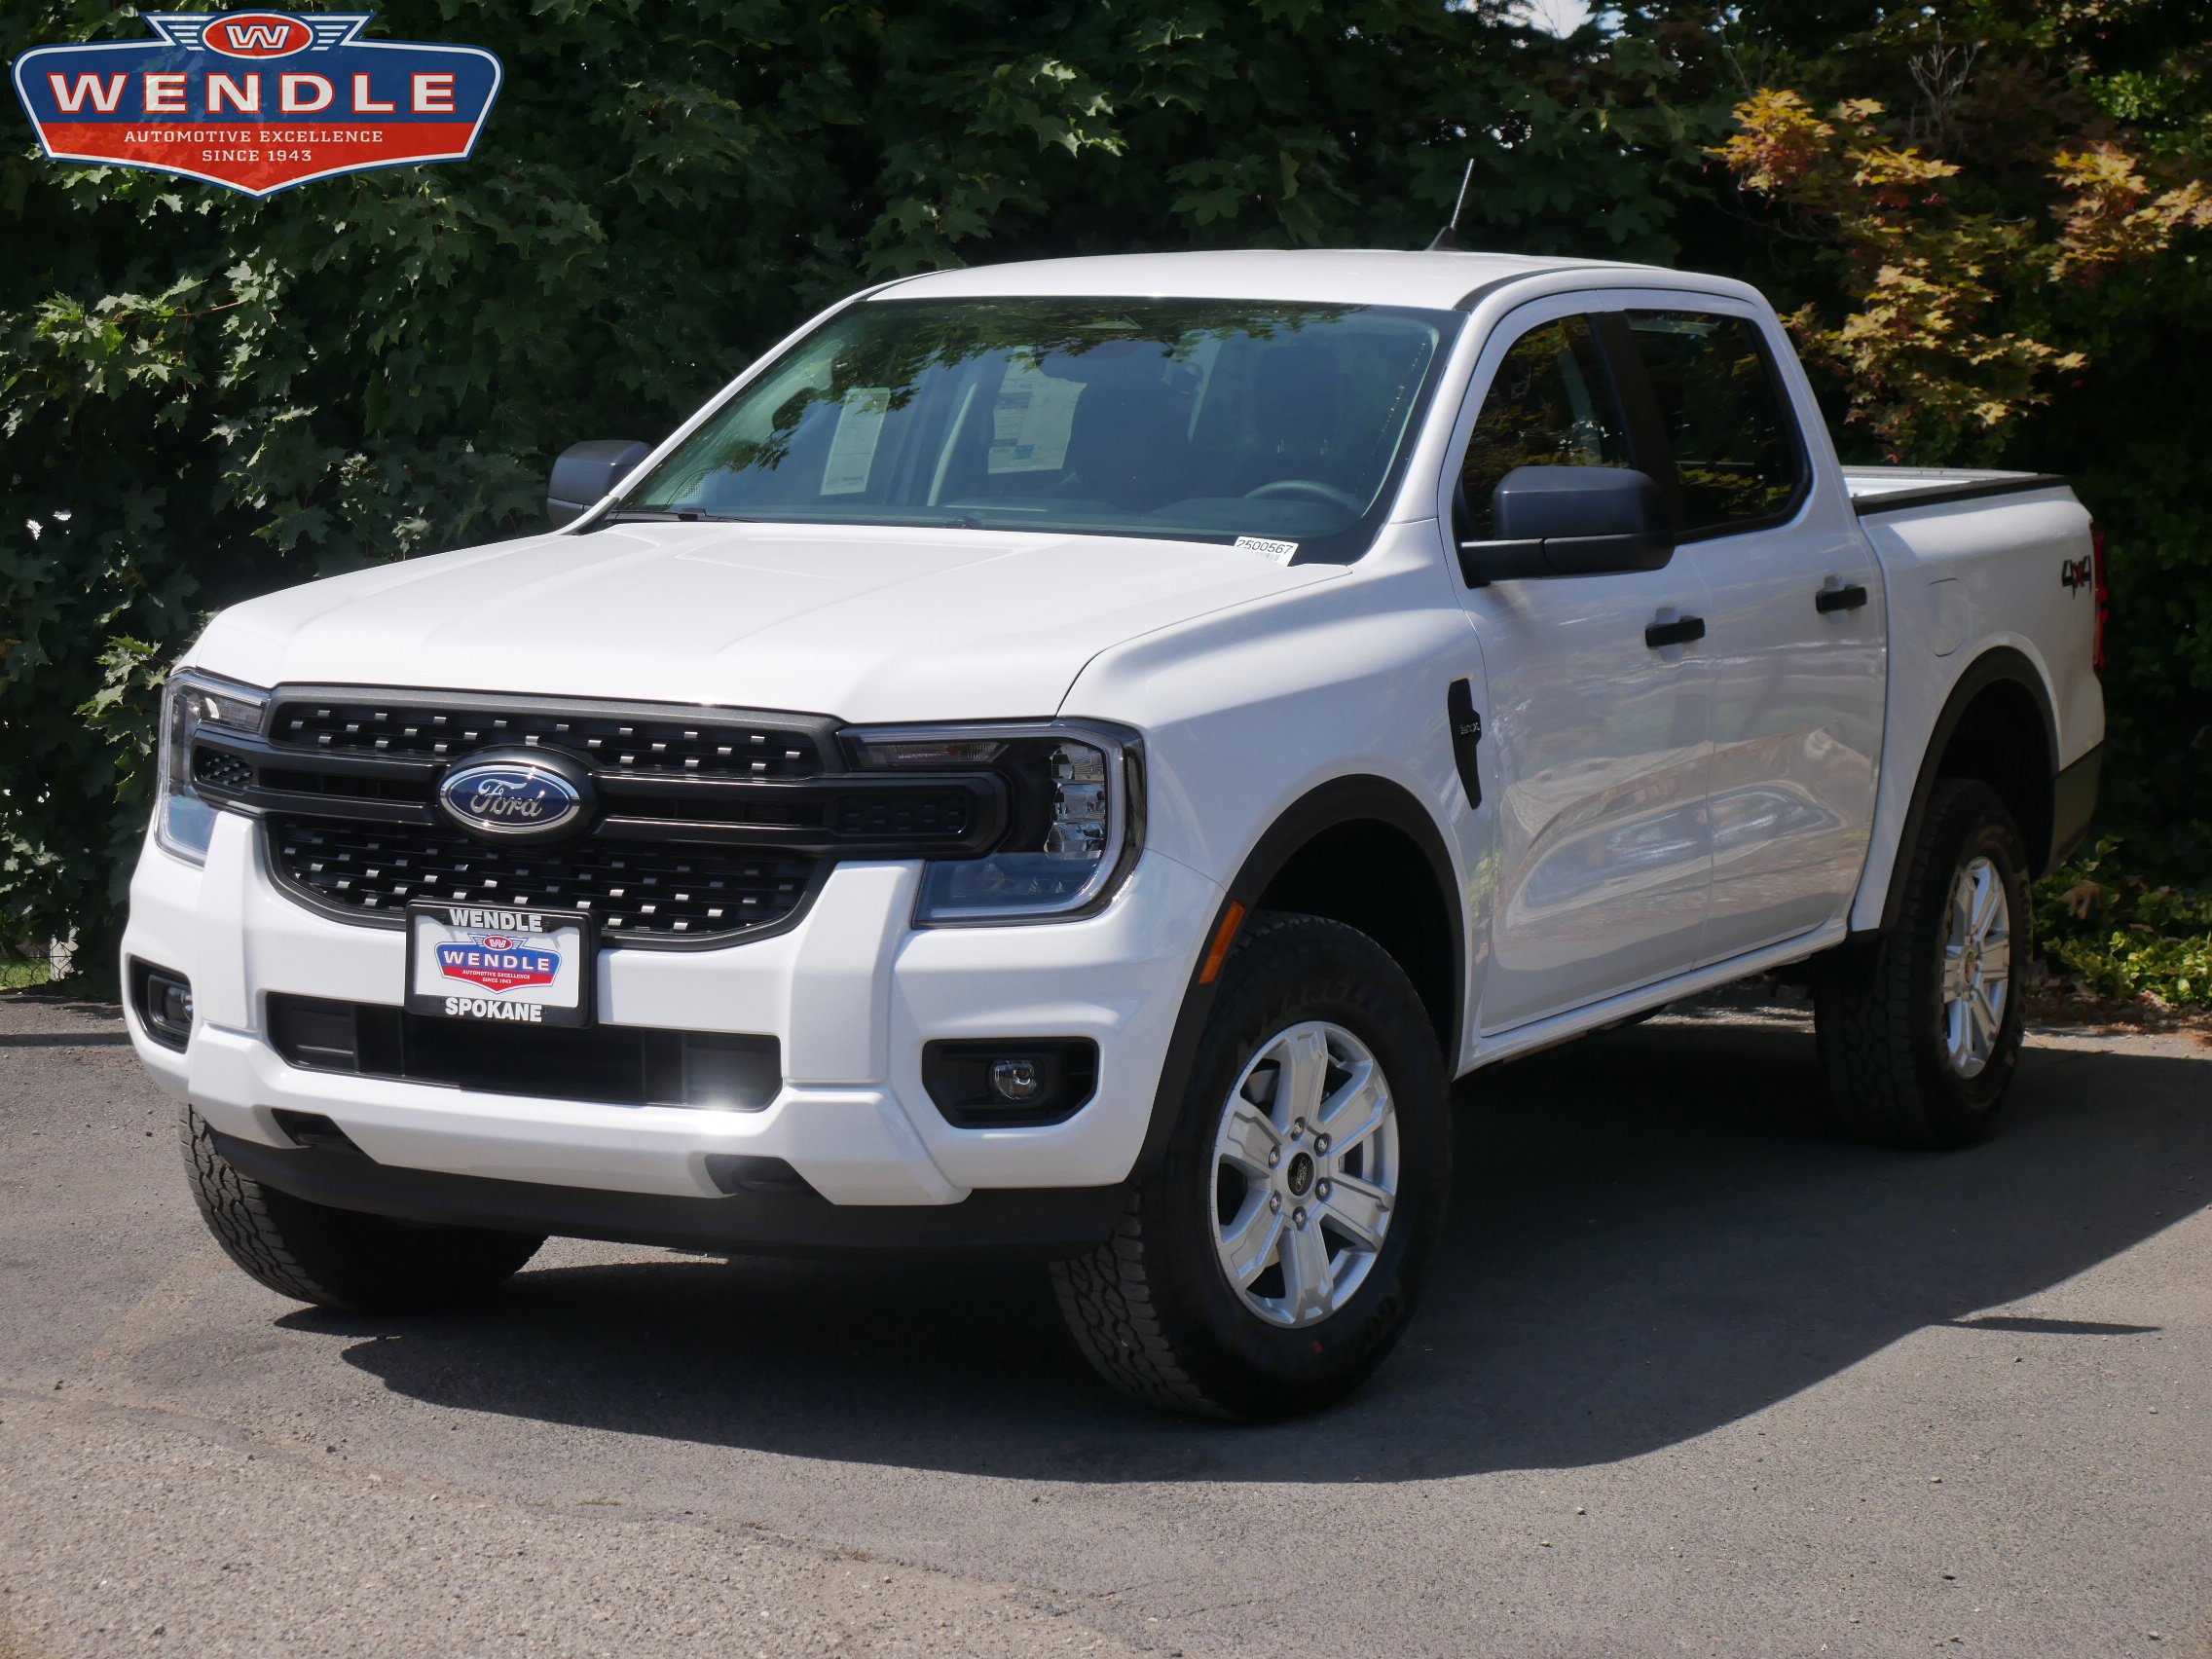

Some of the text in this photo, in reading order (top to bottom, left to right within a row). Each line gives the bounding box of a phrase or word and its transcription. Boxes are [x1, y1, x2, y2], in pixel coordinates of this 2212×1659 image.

[1236, 539, 1293, 555] 2500567
[470, 778, 545, 818] Ford
[449, 908, 543, 933] WENDLE
[443, 950, 550, 972] WENDLE
[497, 971, 532, 979] EXCELLENCE
[445, 997, 542, 1022] SPOKANE
